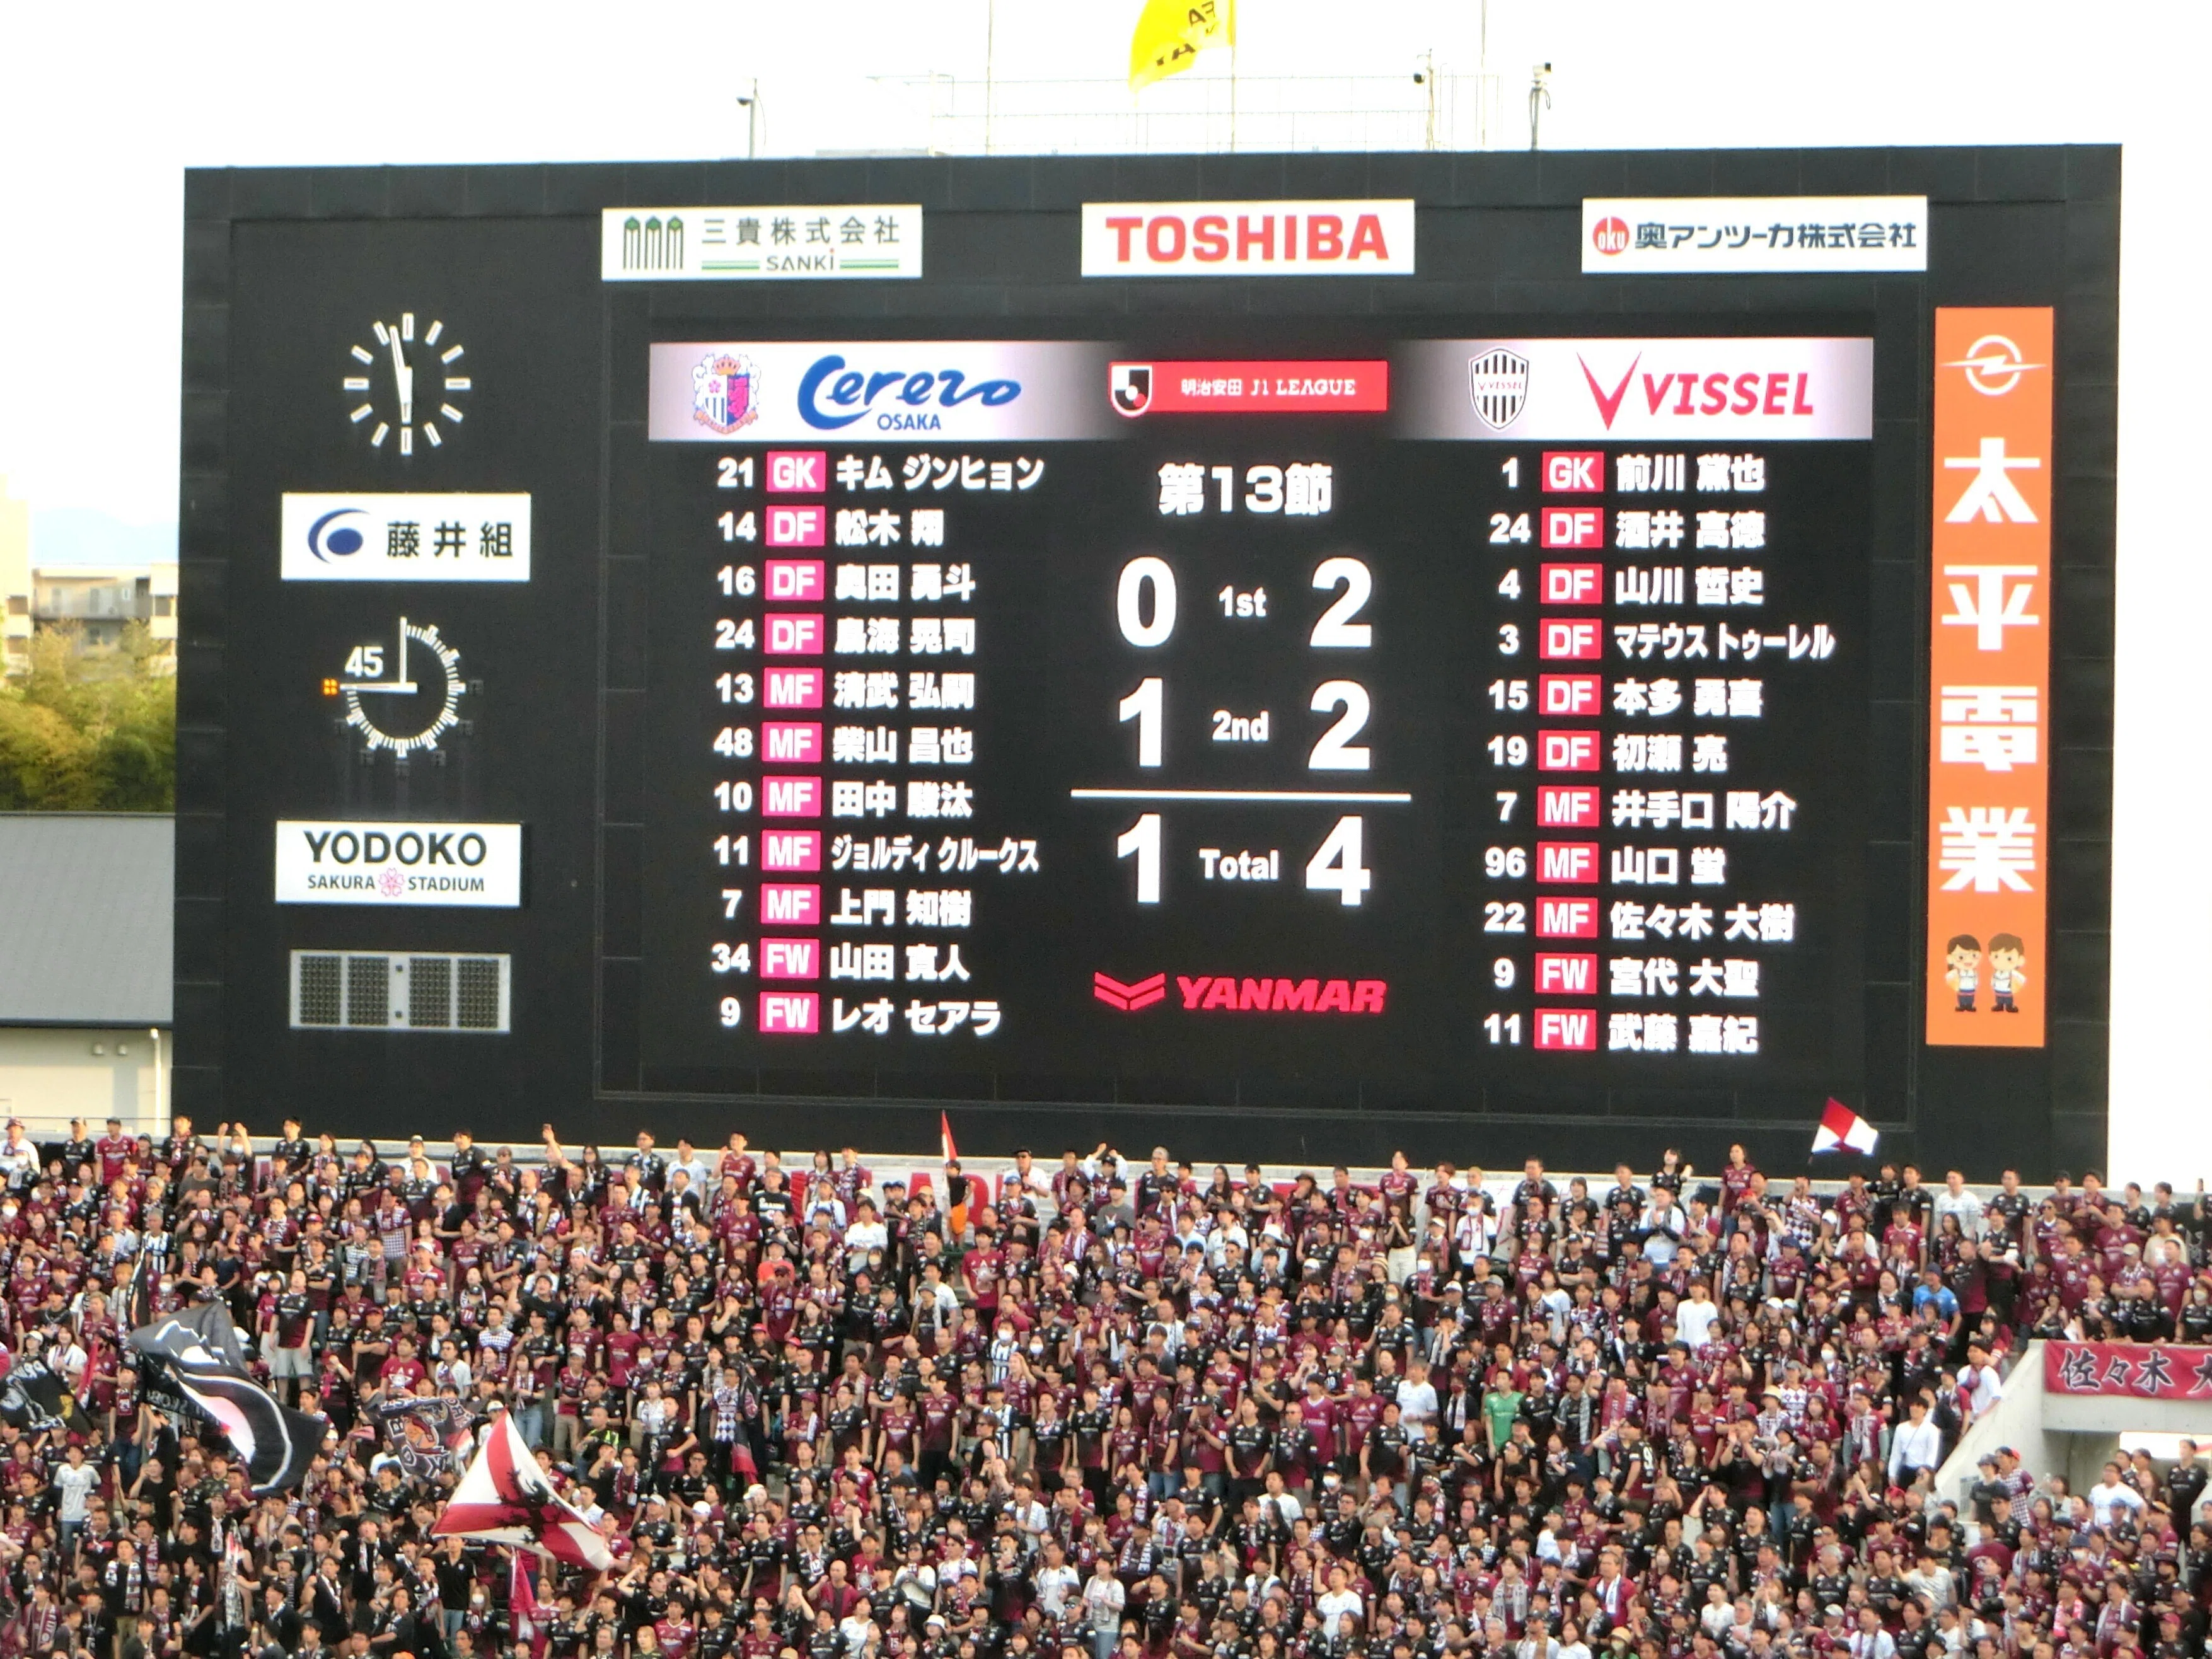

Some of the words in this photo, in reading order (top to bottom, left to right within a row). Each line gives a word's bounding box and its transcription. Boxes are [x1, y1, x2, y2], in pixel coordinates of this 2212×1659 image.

[702, 216, 900, 245] 三貴株式会社
[1107, 216, 1388, 262] TOSHIBA
[1636, 223, 1916, 248] 奥アンツーカ株式会社
[797, 354, 1021, 430] Cerezo
[1181, 379, 1242, 396] 明治安田
[1276, 379, 1355, 395] LEAGUE
[1644, 373, 1813, 415] VISSEL
[877, 413, 941, 431] OSAKA
[717, 458, 753, 487] 21
[773, 457, 816, 488] GK
[837, 454, 893, 490] キム
[903, 454, 1044, 490] ジンヒョン
[1158, 463, 1332, 516] 第13節
[1503, 458, 1518, 487] 1
[1549, 457, 1594, 488] GK
[1616, 454, 1685, 491] 前川
[386, 521, 512, 557] 藤井組
[719, 512, 756, 541] 14
[774, 512, 816, 542] DF
[1490, 514, 1531, 543] 24
[1550, 514, 1594, 544] DF
[1616, 511, 1684, 548] 酒井
[718, 566, 755, 595] 16
[773, 566, 815, 596] DF
[835, 564, 899, 601] 奥田
[1499, 569, 1520, 599] 4
[1549, 570, 1594, 599] DF
[1616, 567, 1683, 604] 山川
[1695, 567, 1763, 604] 哲史
[1118, 557, 1176, 647] 0
[1219, 586, 1266, 616] 1st
[1310, 558, 1372, 647] 2
[715, 620, 755, 649] 24
[773, 620, 814, 650] DF
[910, 618, 975, 654] 晃司
[1499, 625, 1519, 654] 3
[1548, 625, 1593, 656] DF
[1614, 623, 1708, 659] マテウス
[1719, 623, 1836, 660] トゥーレル
[345, 646, 383, 677] 45
[1939, 438, 2041, 893] 太平電業
[716, 673, 753, 703] 13
[771, 674, 814, 704] MF
[1489, 679, 1528, 710] 15
[1548, 681, 1592, 711] DF
[1613, 678, 1682, 716] 本多
[1120, 678, 1162, 766] 1
[1213, 710, 1269, 741] 2nd
[1309, 681, 1370, 770] 2
[714, 727, 753, 757] 48
[770, 729, 812, 758] MF
[909, 727, 973, 763] 昌也
[1488, 736, 1527, 766] 19
[1546, 737, 1590, 767] DF
[714, 782, 752, 811] 10
[770, 783, 812, 811] MF
[833, 780, 896, 817] 田中
[1497, 792, 1517, 821] 7
[1545, 792, 1590, 822] MF
[1612, 790, 1713, 828] 井手口
[1727, 791, 1796, 830] 陽介
[303, 831, 487, 867] YODOKO
[714, 836, 748, 865] 11
[769, 836, 811, 866] MF
[938, 836, 1039, 872] クルークス
[1118, 814, 1161, 903] 1
[1200, 849, 1278, 880] Total
[1306, 816, 1370, 906] 4
[1485, 847, 1526, 877] 96
[1544, 848, 1590, 878] MF
[1612, 846, 1678, 884] 山口
[308, 875, 375, 889] SAKURA
[408, 876, 485, 892] STADIUM
[722, 889, 742, 918] 7
[768, 890, 811, 919] MF
[831, 888, 895, 925] 上門
[1484, 902, 1525, 932] 22
[1544, 903, 1589, 933] MF
[1611, 901, 1713, 940] 佐々木
[1725, 903, 1795, 941] 大樹
[712, 943, 751, 972] 34
[767, 944, 810, 973] FW
[830, 942, 894, 980] 山田
[1494, 958, 1515, 988] 9
[1543, 959, 1588, 989] FW
[1610, 957, 1678, 995] 宮代
[1689, 959, 1759, 997] 大聖
[1176, 975, 1387, 1015] YANMAR
[721, 997, 740, 1027] 9
[767, 998, 809, 1027] FW
[833, 998, 894, 1034] レオ
[905, 1000, 1000, 1036] セアラ
[1485, 1014, 1520, 1044] 11
[1543, 1015, 1587, 1045] FW
[1609, 1013, 1677, 1051] 武藤
[2058, 1348, 2176, 1394] 佐々木
